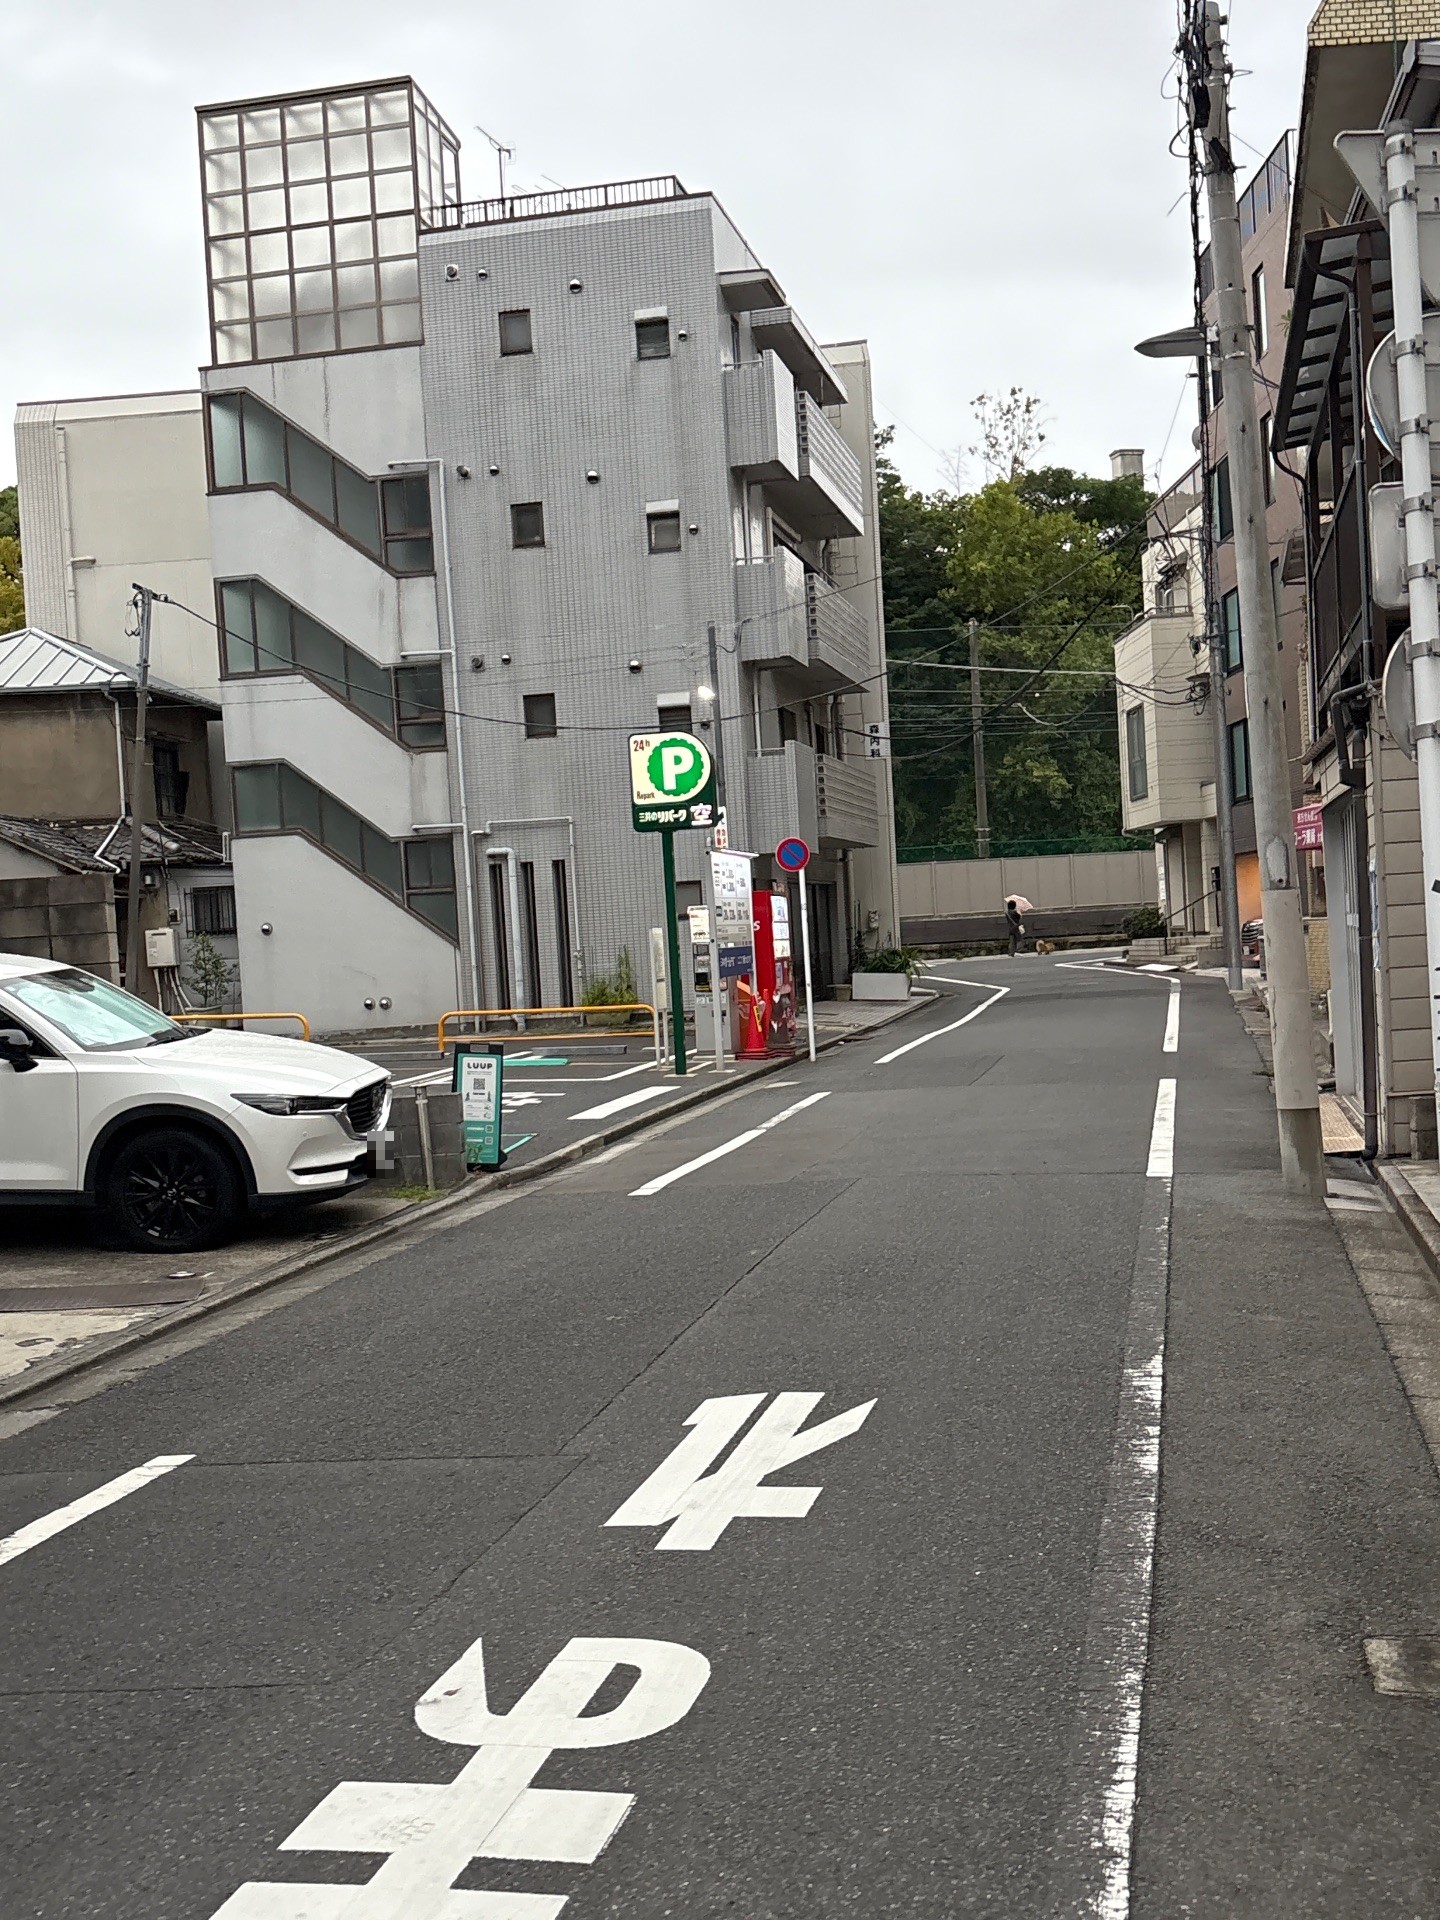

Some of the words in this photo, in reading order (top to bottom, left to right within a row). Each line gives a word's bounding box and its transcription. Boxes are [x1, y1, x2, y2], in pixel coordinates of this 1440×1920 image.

[661, 746, 694, 791] P
[636, 791, 655, 800] Repark
[638, 809, 687, 823] 三井のリパーク
[690, 803, 713, 826] 空
[467, 1062, 493, 1070] LUUP
